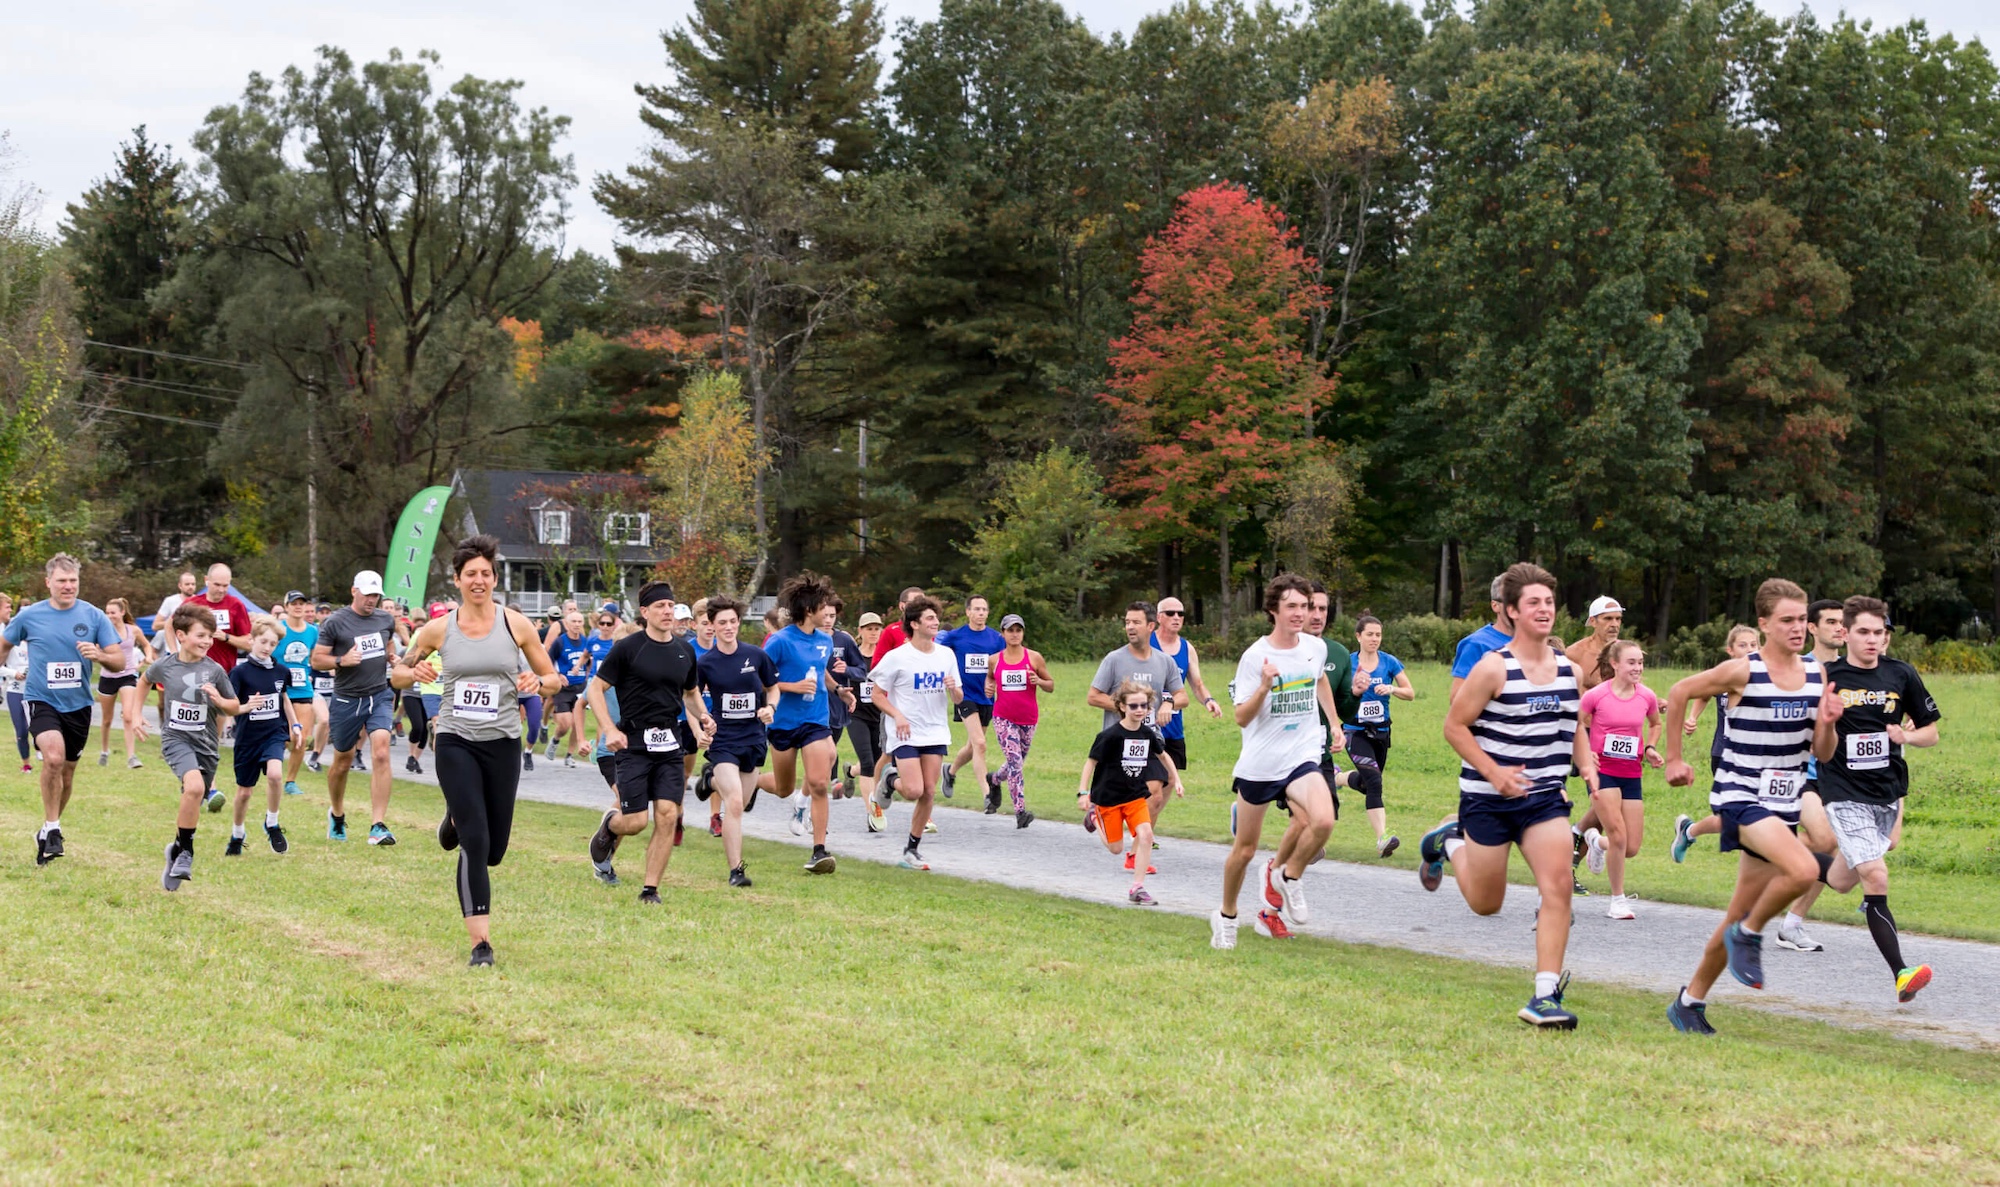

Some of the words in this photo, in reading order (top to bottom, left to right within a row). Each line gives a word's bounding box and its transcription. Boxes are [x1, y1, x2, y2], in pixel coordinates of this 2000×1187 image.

[361, 638, 379, 651] 942
[970, 657, 985, 666] 945
[54, 667, 75, 679] 949
[1006, 674, 1022, 684] 863
[1133, 672, 1152, 681] CAN'T
[463, 690, 491, 706] 975
[729, 699, 749, 710] 964
[1526, 695, 1561, 713] TOGA
[1271, 700, 1314, 714] NATIONALS
[1363, 705, 1380, 716] 889
[1770, 701, 1808, 719] TOGA
[177, 708, 200, 721] 903
[1129, 745, 1145, 757] 929
[1611, 740, 1632, 753] 925
[1856, 740, 1882, 756] 868
[1769, 779, 1794, 796] 650
